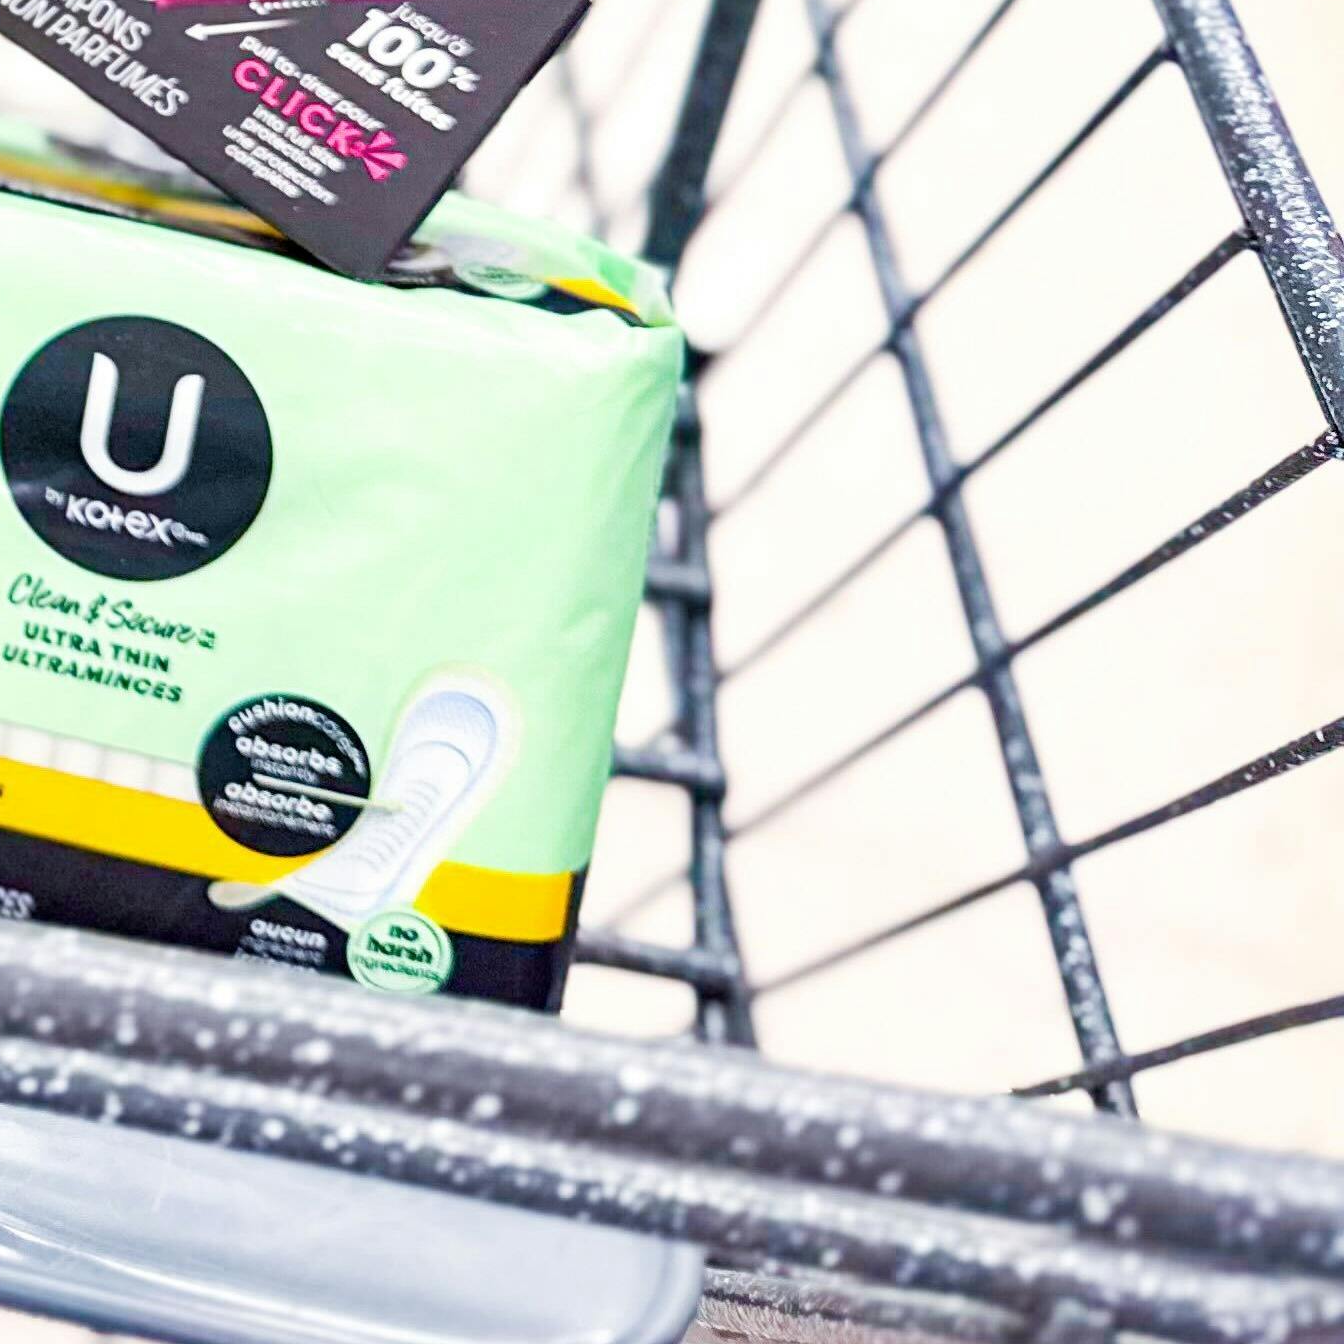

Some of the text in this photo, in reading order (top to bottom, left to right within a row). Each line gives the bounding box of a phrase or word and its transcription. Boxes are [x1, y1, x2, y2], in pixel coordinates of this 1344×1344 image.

[44, 12, 190, 118] PARFUMÉS
[325, 42, 391, 86] sans
[346, 8, 481, 93] 100%
[333, 99, 387, 132] pour
[240, 117, 326, 177] protection
[250, 145, 339, 205] protection
[80, 351, 206, 496] U
[8, 572, 81, 616] Clean
[105, 599, 197, 643] Secure
[2, 643, 182, 703] ULTRAMINCES
[23, 621, 169, 673] ULTRA THIN
